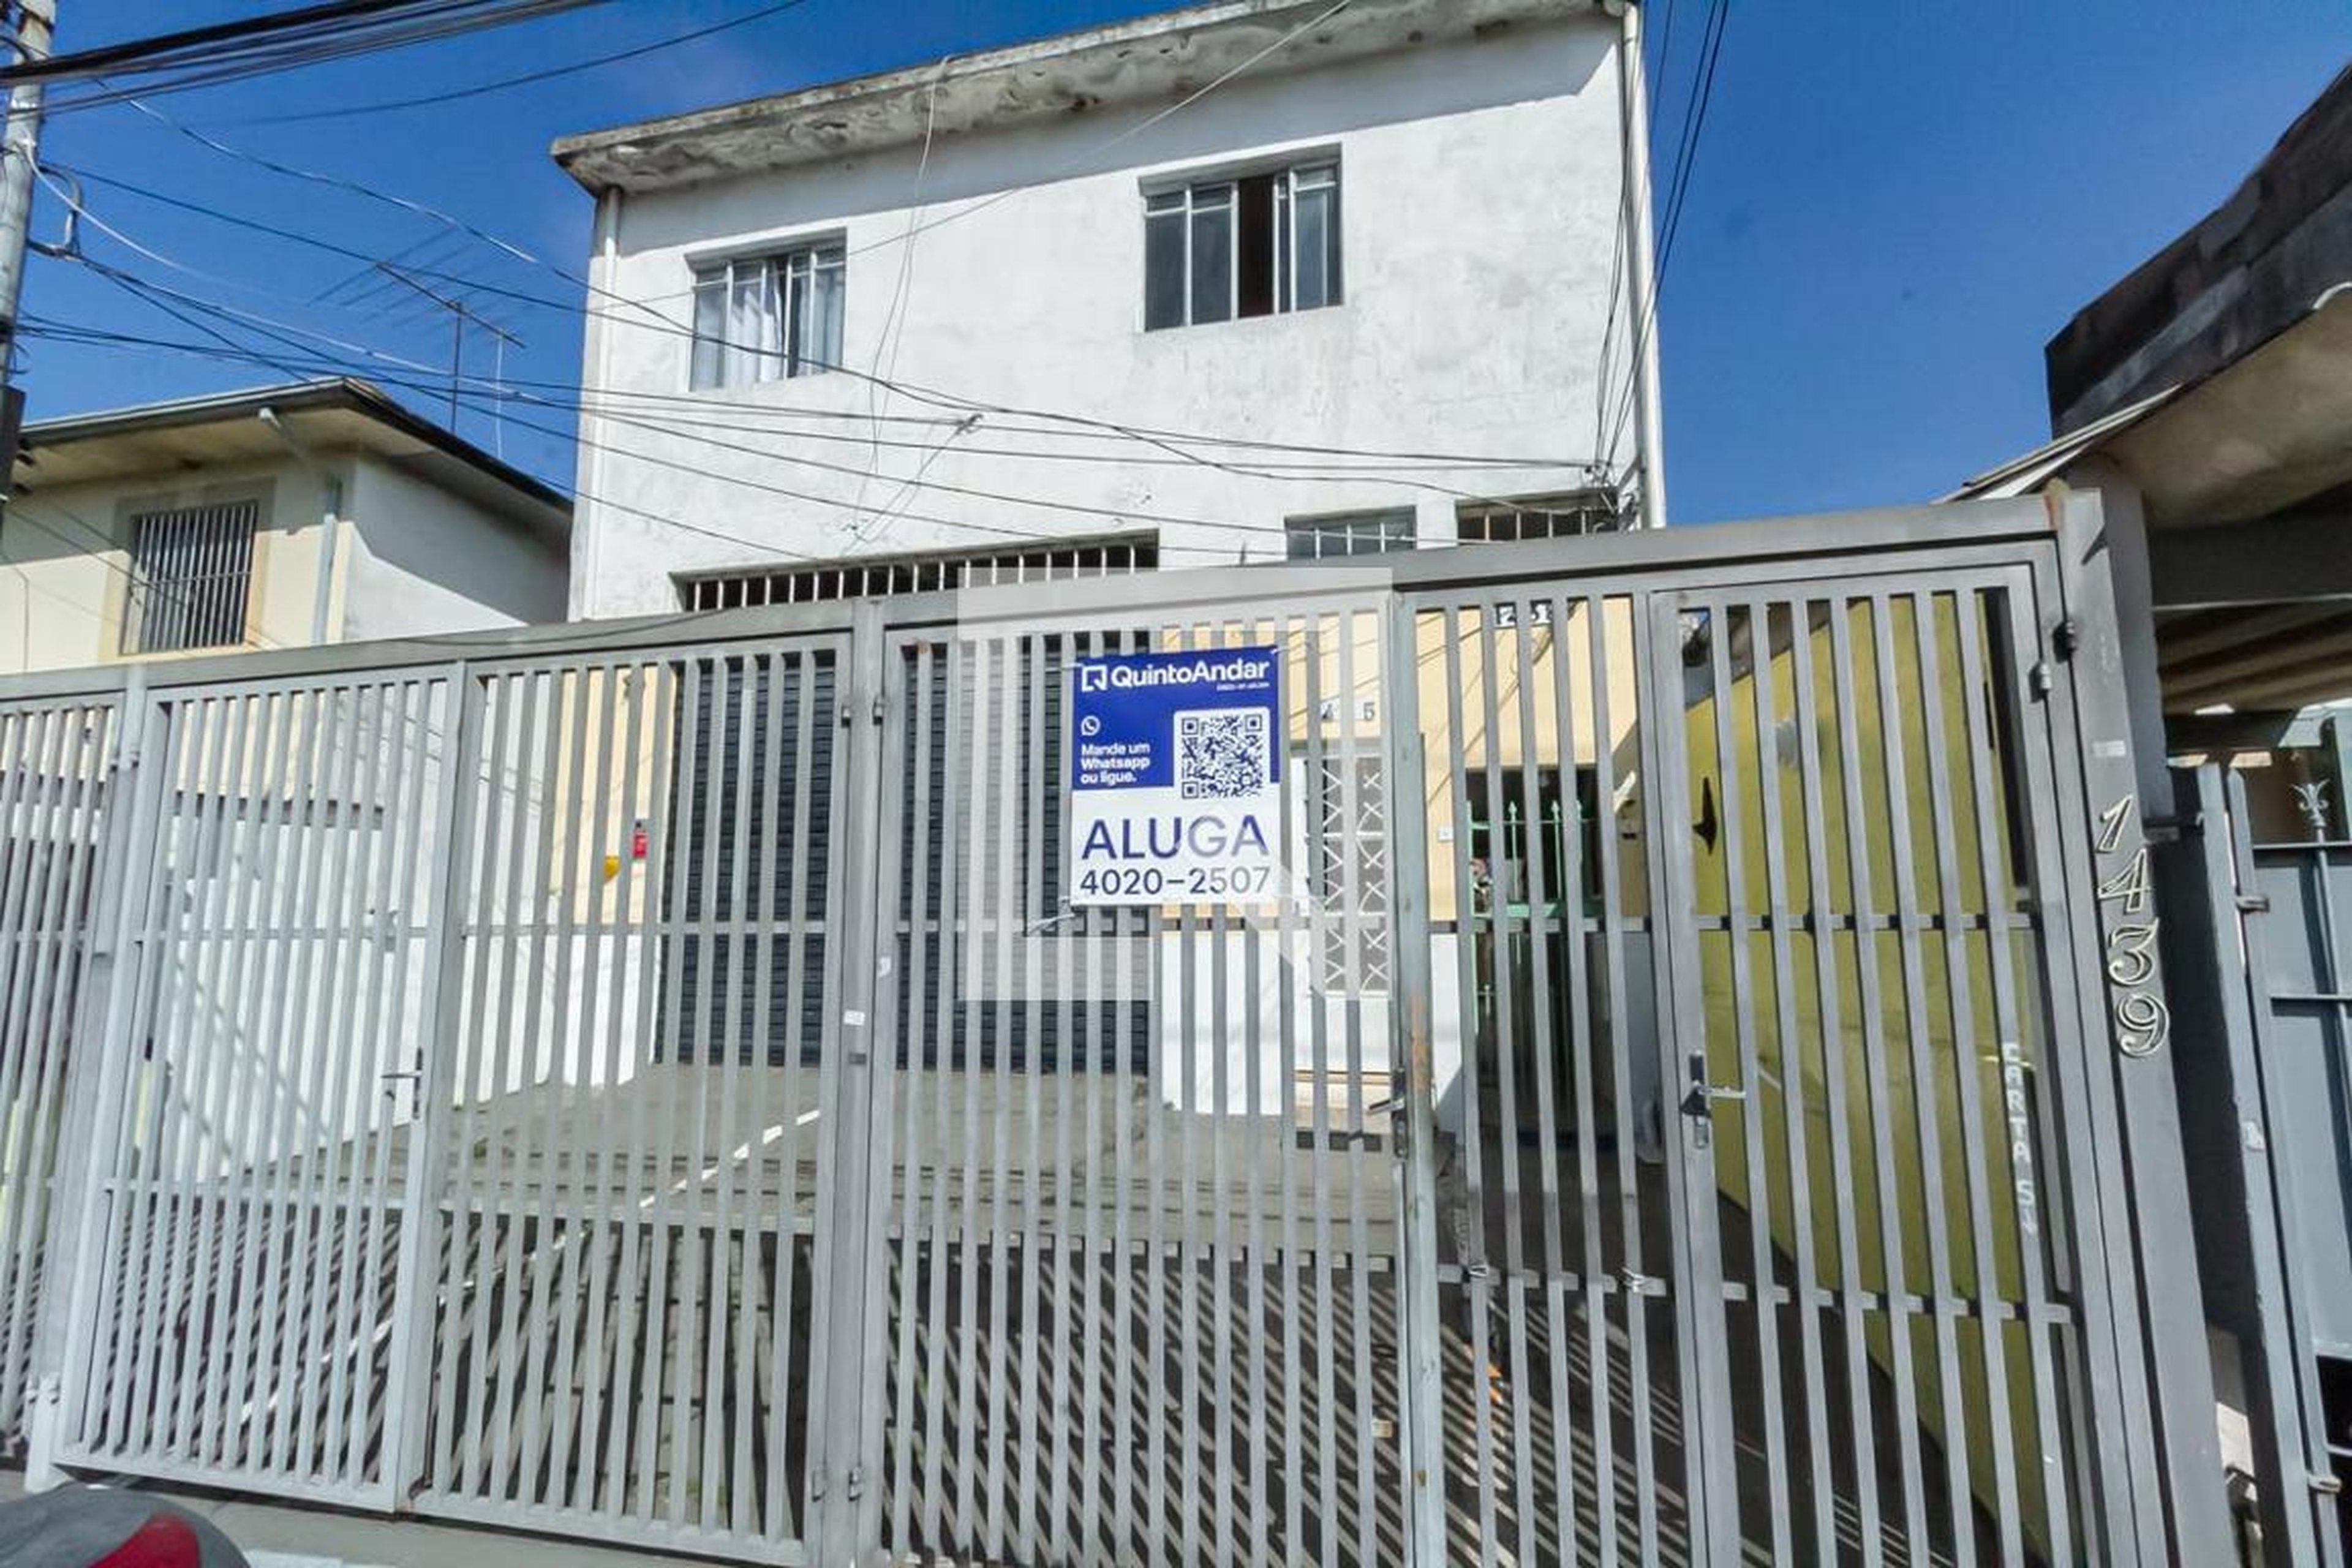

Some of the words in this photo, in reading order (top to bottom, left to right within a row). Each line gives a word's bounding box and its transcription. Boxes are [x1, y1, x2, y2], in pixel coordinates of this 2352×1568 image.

[1110, 658, 1270, 687] QuintoAndar
[1081, 757, 1151, 771] Whatsapp
[1082, 743, 1126, 756] Mande
[1128, 744, 1151, 754] um
[1080, 773, 1098, 784] ou
[1100, 770, 1137, 786] ligue.
[1081, 815, 1270, 859] ALUGA
[1080, 865, 1270, 895] 4020-2507
[2094, 794, 2170, 1058] 1439
